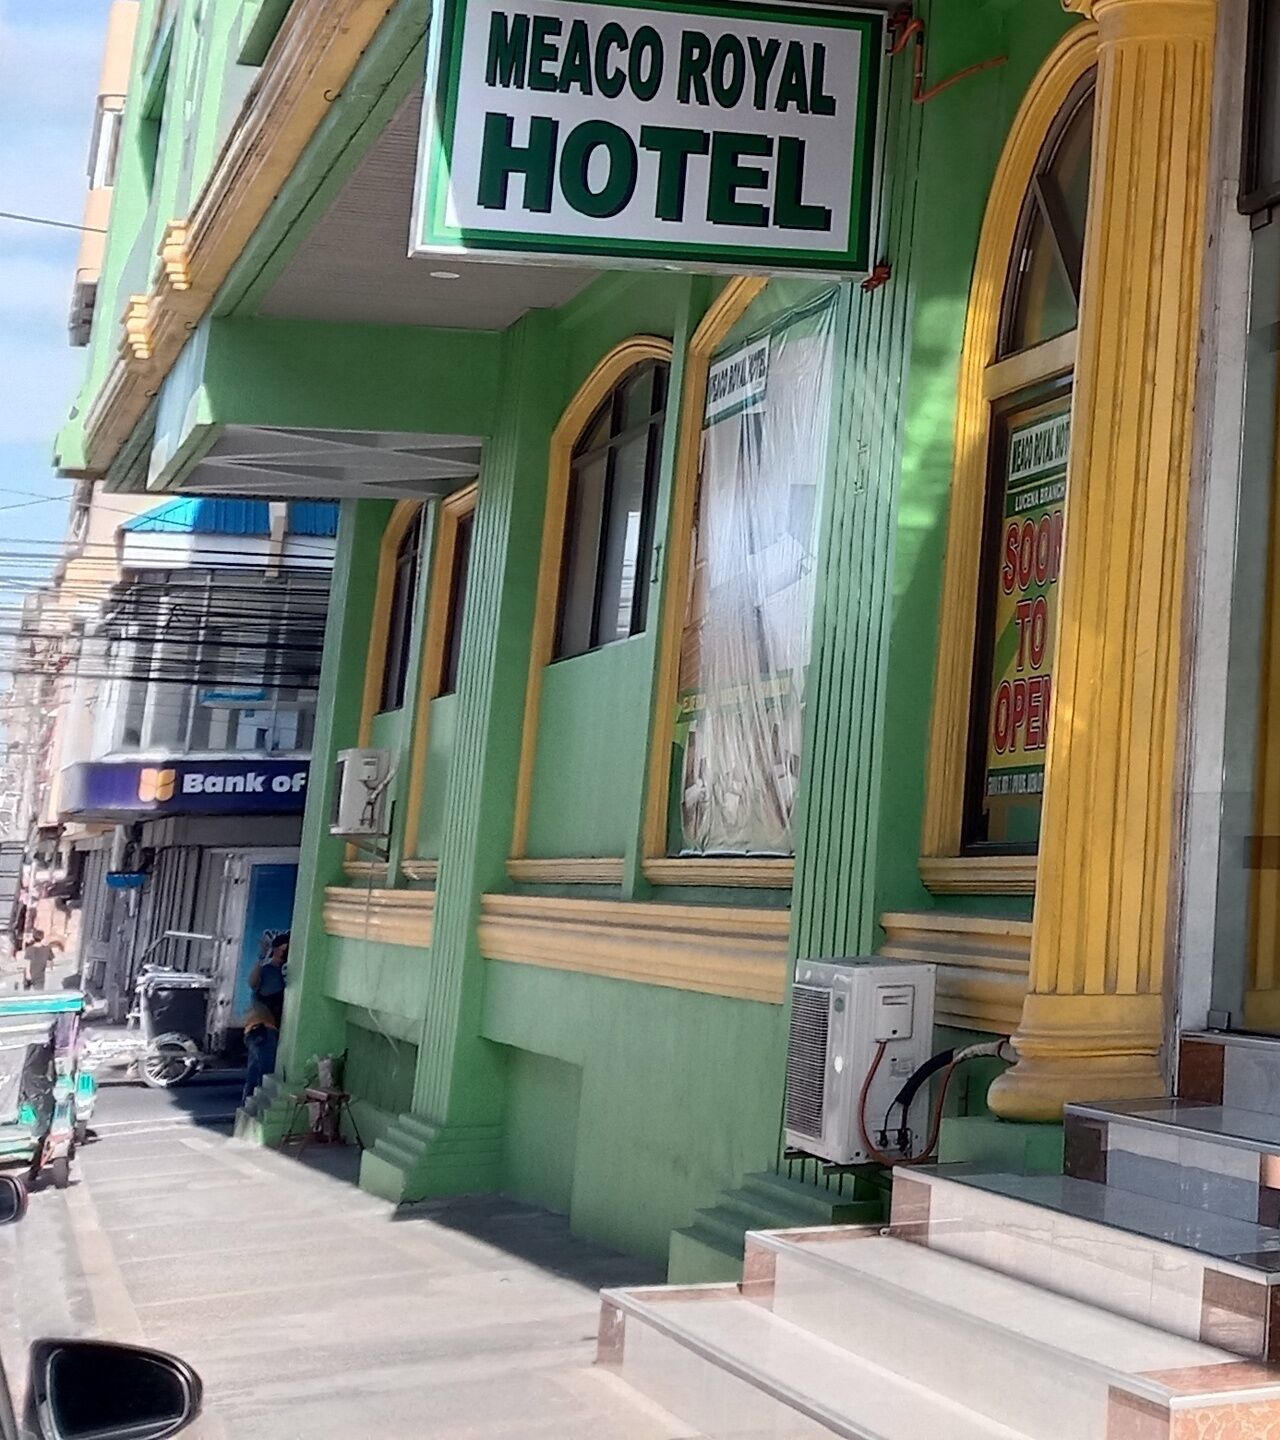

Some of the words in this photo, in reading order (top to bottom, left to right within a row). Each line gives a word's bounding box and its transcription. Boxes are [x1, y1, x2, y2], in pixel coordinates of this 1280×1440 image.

[485, 11, 664, 102] MEACO
[677, 29, 836, 116] ROYAL
[477, 111, 831, 232] HOTEL
[1015, 594, 1048, 672] TO
[182, 773, 264, 793] Bank
[271, 772, 306, 793] of
